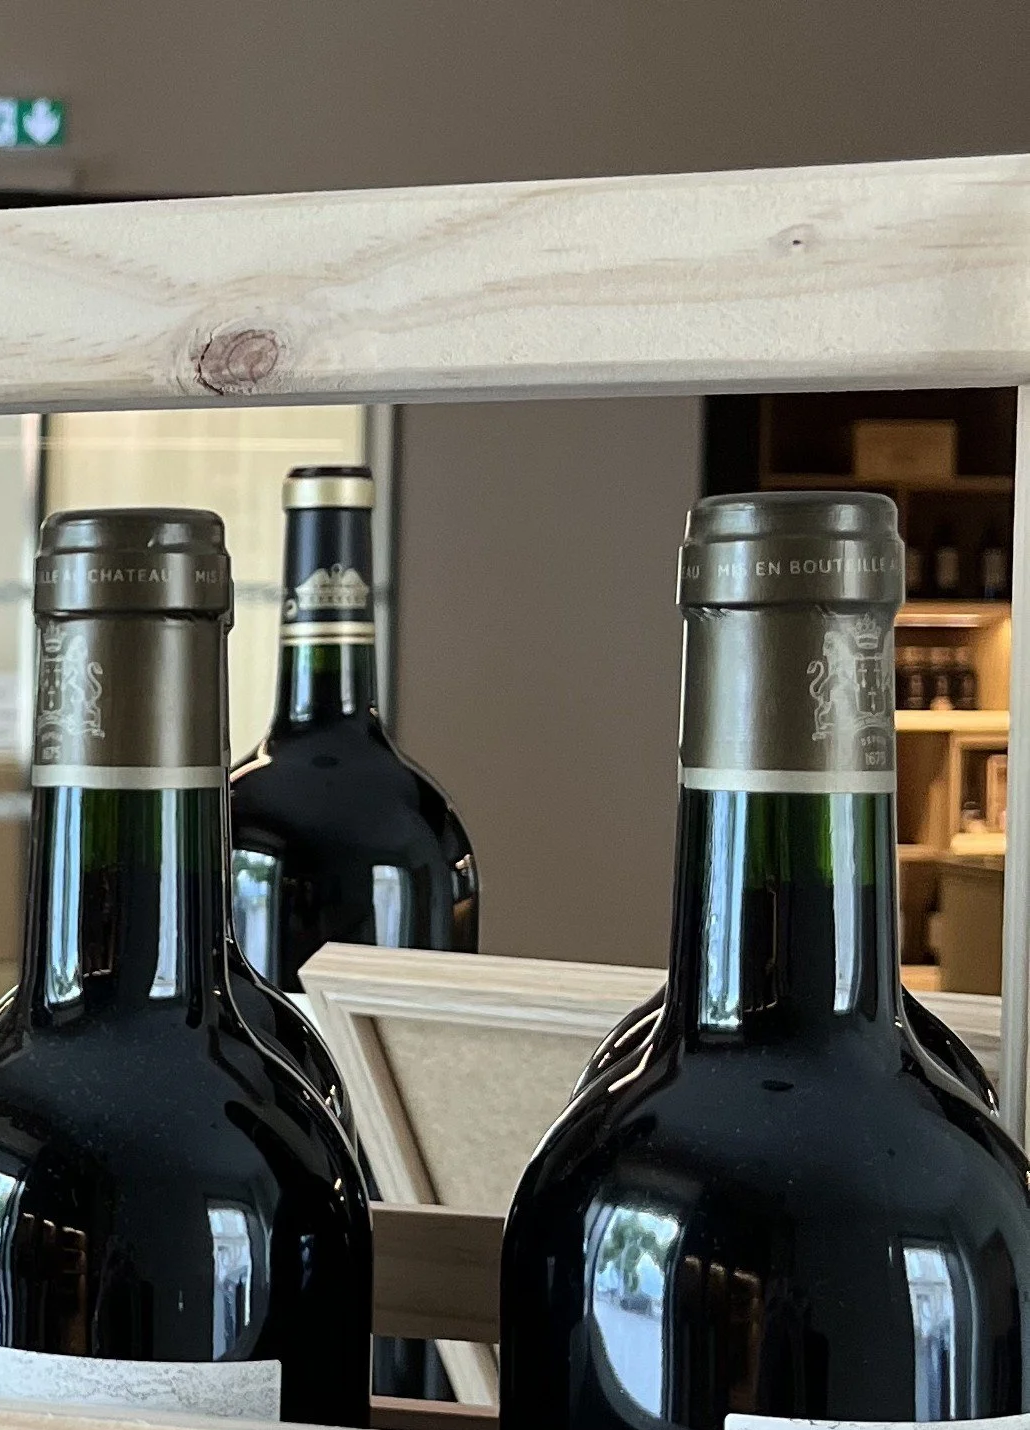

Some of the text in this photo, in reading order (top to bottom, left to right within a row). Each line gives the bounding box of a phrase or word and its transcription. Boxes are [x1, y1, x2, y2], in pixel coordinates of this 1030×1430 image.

[87, 567, 172, 583] CHATEAU
[194, 569, 218, 585] MIS
[755, 560, 781, 577] EN
